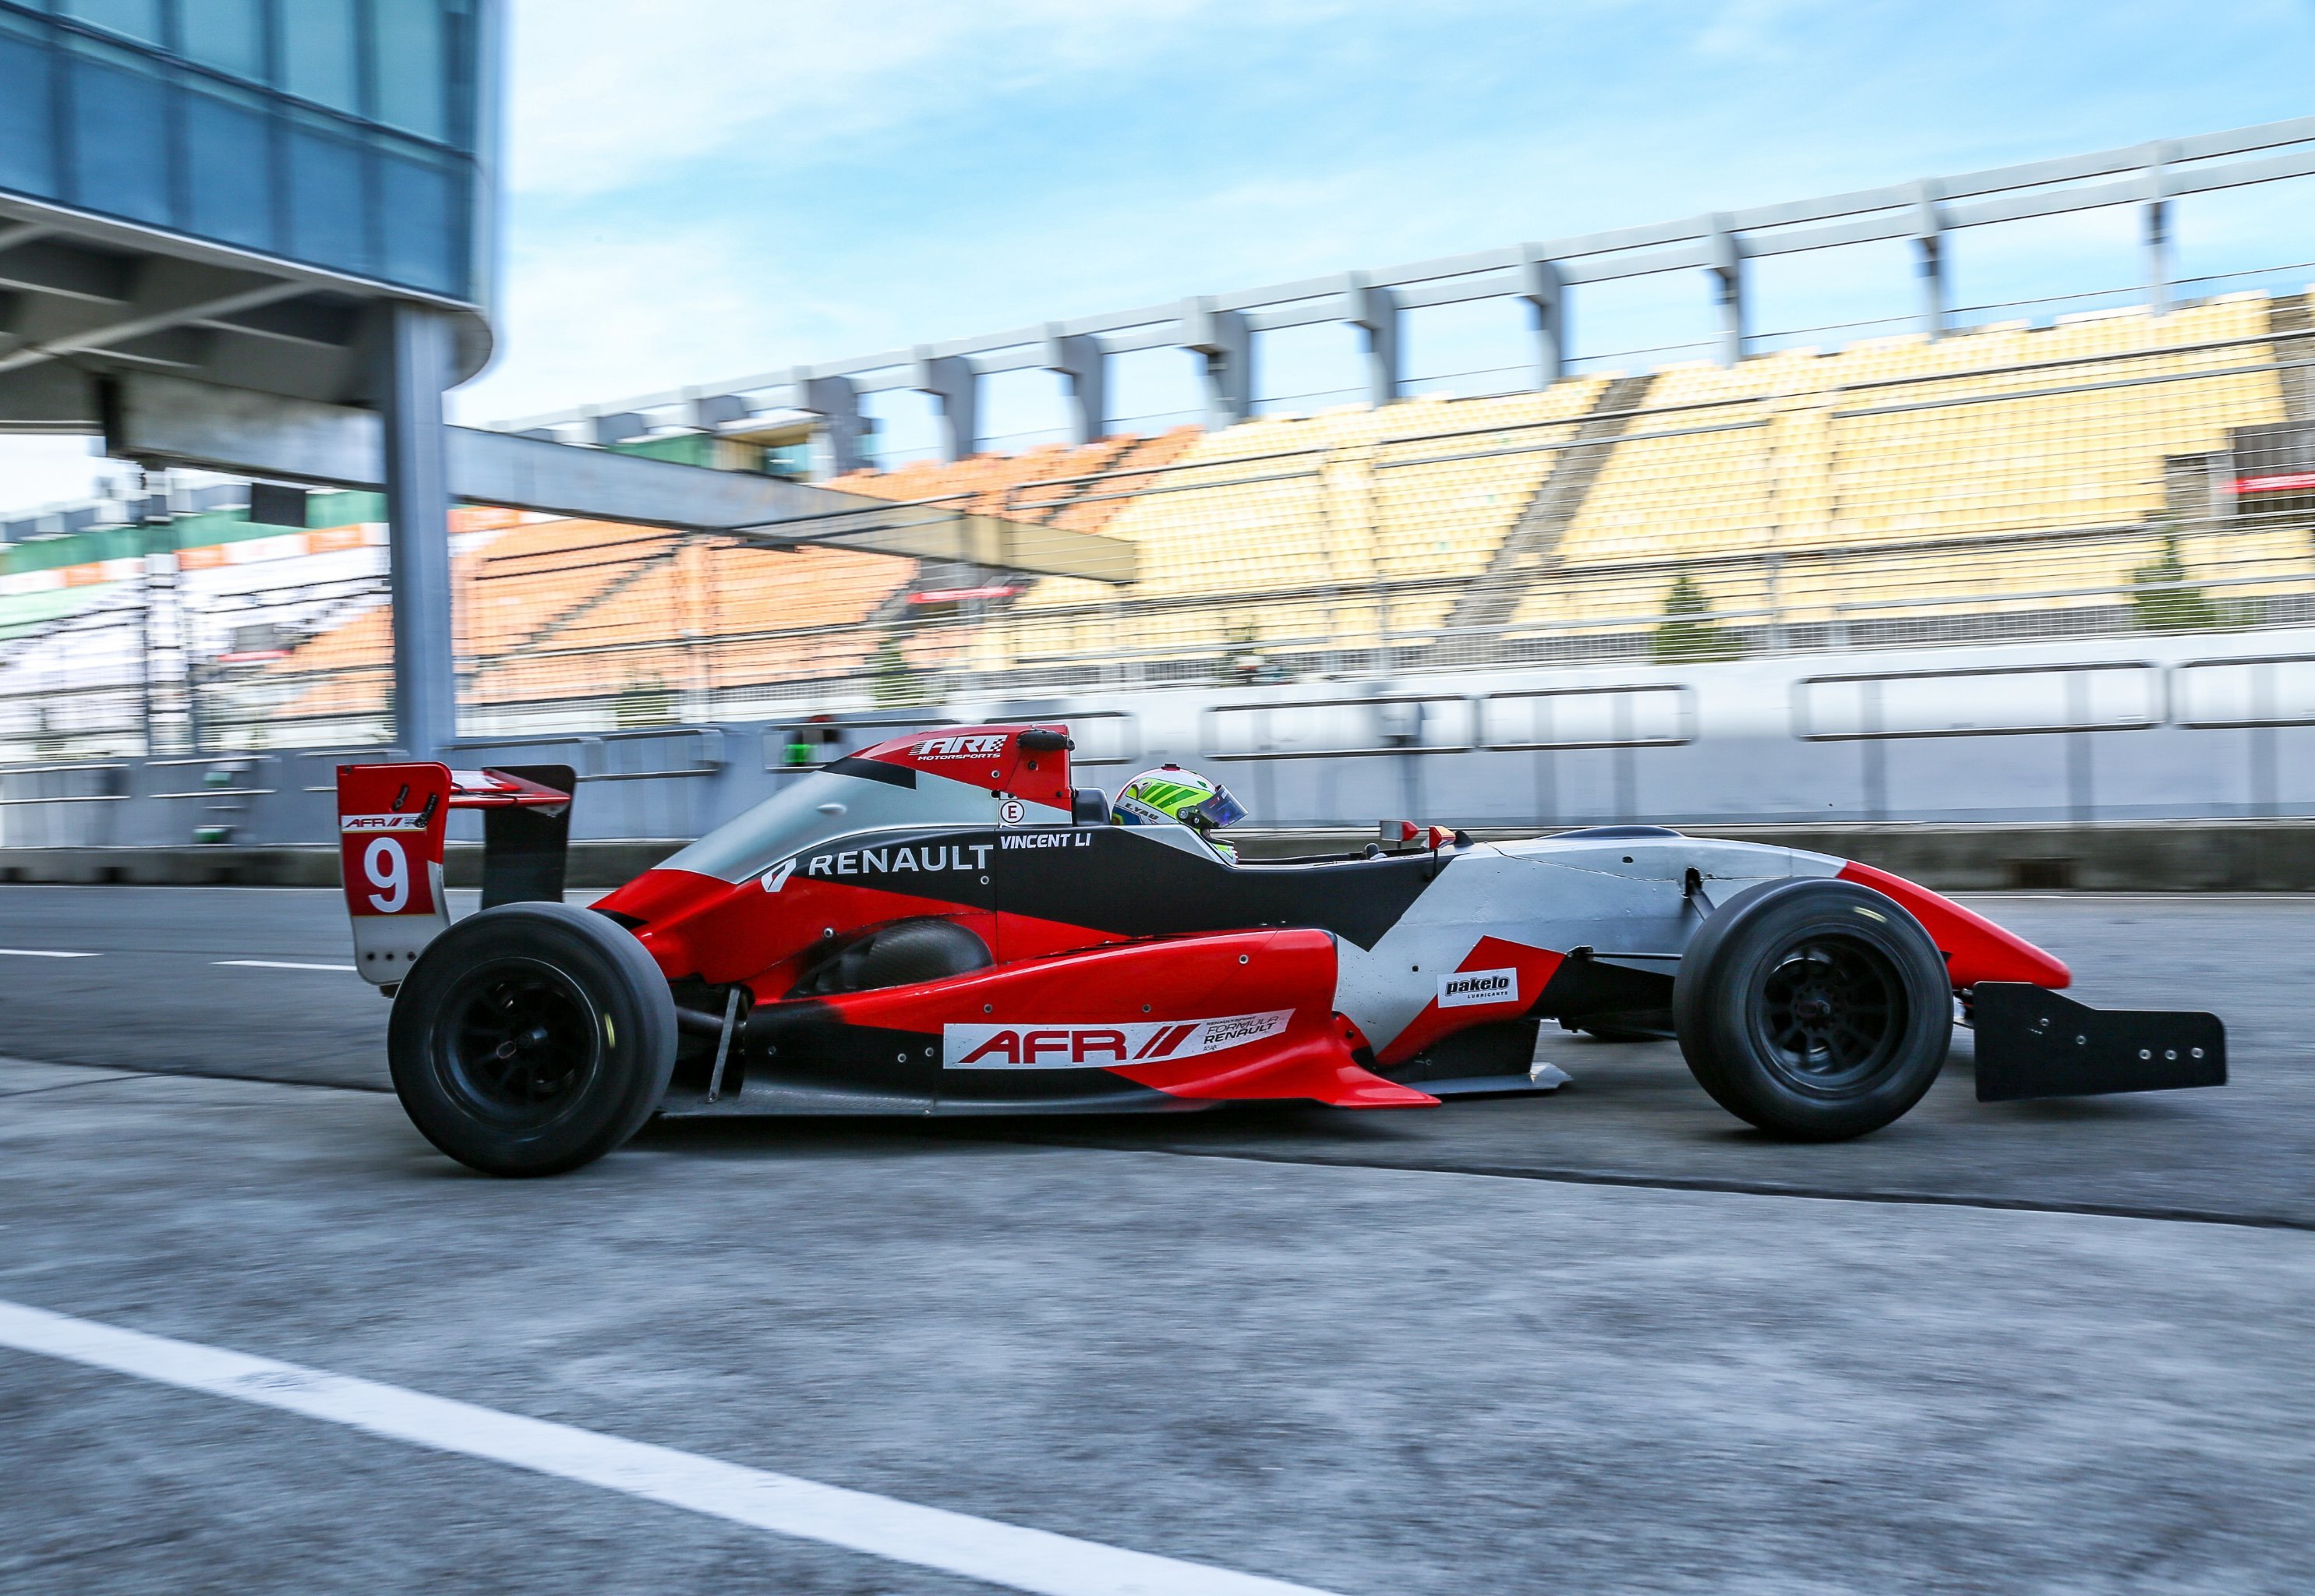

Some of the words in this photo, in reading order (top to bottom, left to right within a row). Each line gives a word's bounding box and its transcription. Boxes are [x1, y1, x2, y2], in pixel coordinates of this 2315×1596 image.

[1008, 805, 1017, 819] E
[345, 818, 385, 828] AFR
[1001, 834, 1071, 849] VINCENT
[1075, 833, 1091, 846] LI
[808, 845, 994, 876] RENAULT
[363, 836, 409, 913] 9
[1445, 975, 1510, 997] pakelo
[1467, 990, 1508, 999] LUBRICANTS
[1203, 1022, 1276, 1044] RENAULT
[1207, 1016, 1278, 1034] FORMULA
[957, 1029, 1128, 1065] AFR
